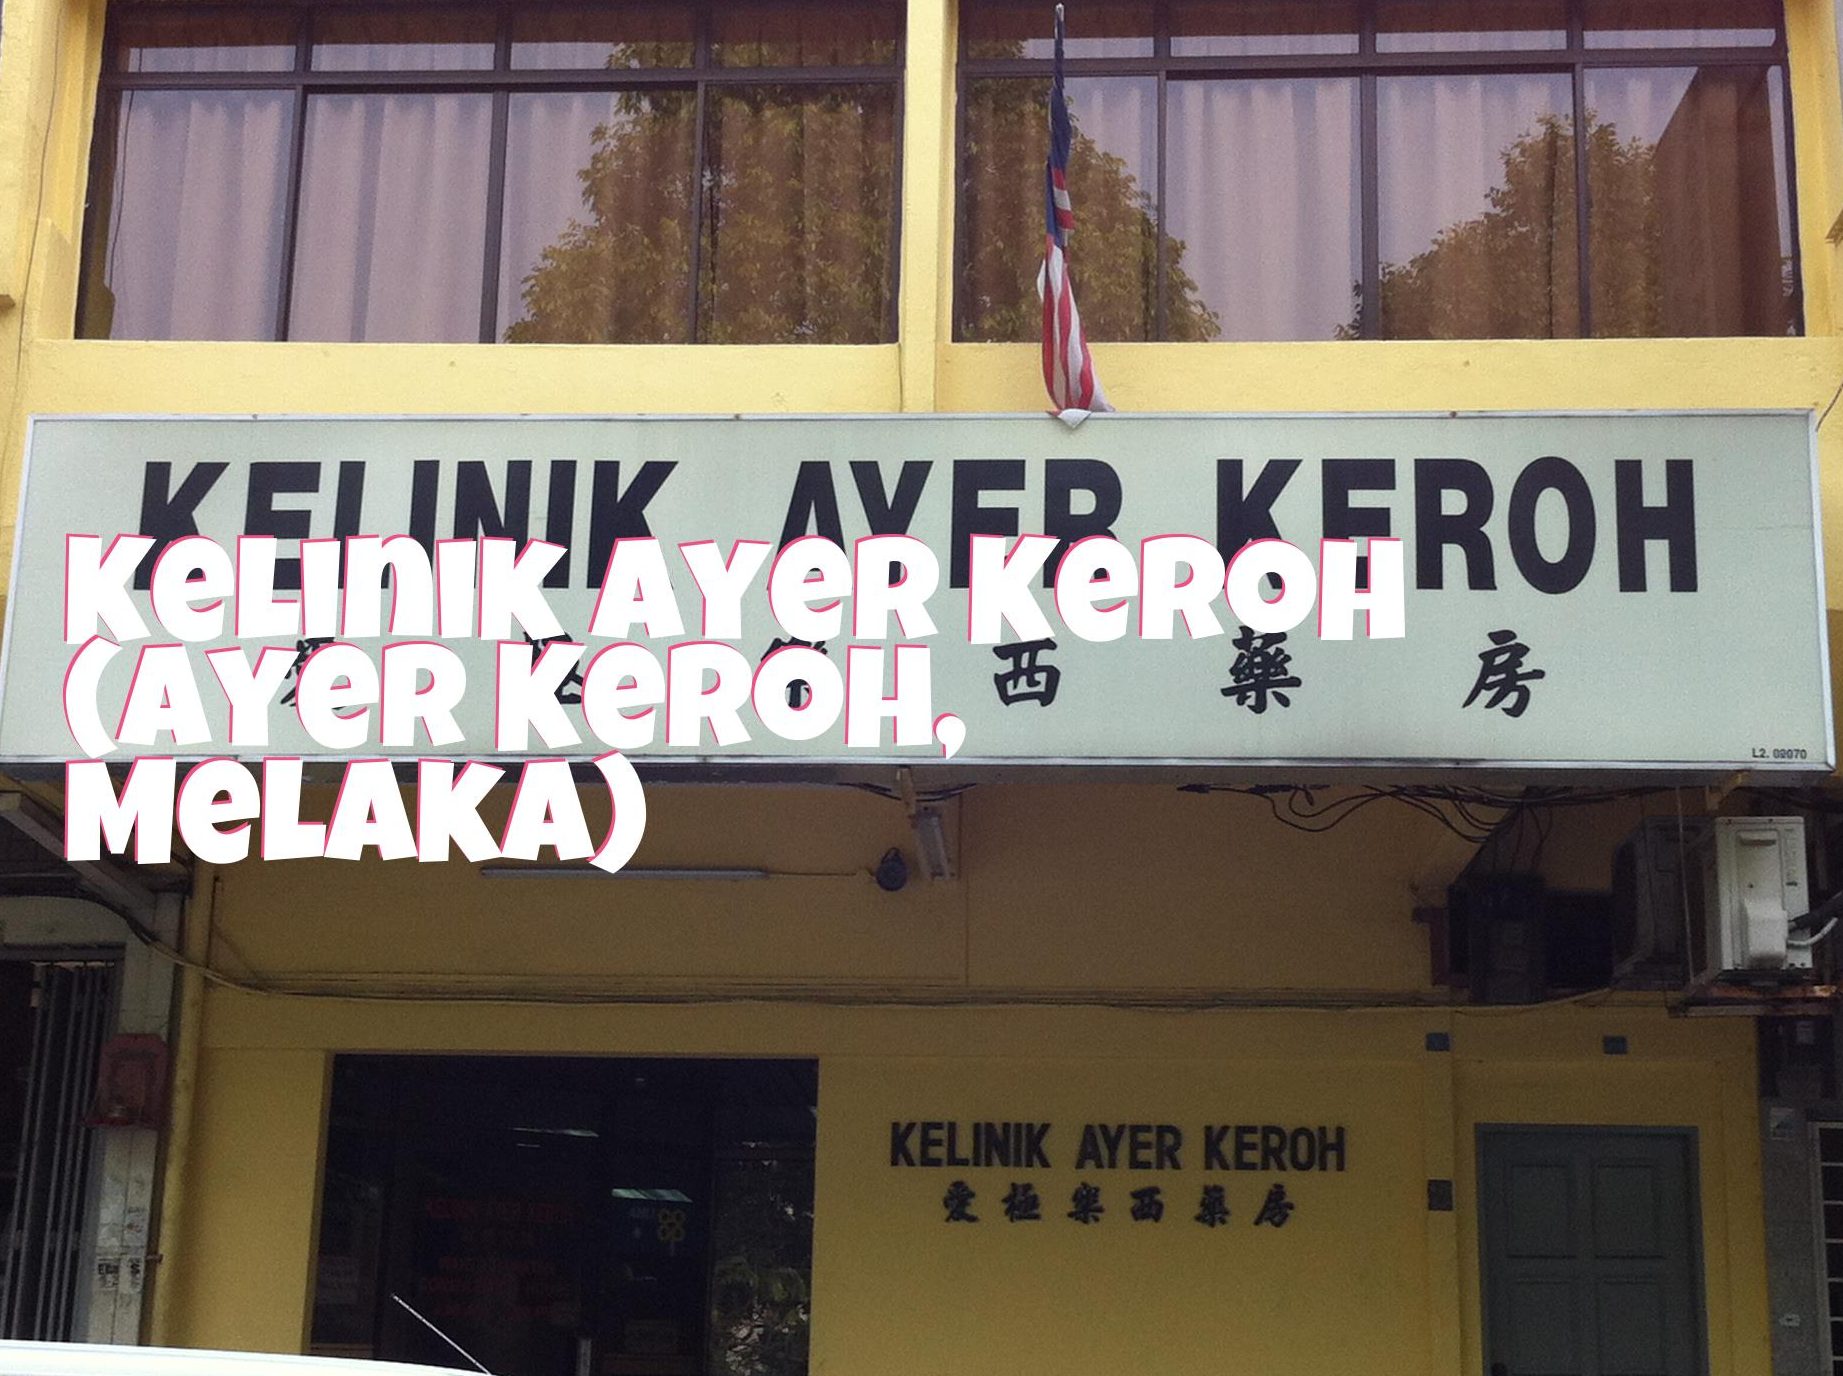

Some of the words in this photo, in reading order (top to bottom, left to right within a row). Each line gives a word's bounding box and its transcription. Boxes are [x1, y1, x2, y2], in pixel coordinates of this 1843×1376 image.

[1216, 456, 1699, 595] KEROH
[890, 1121, 1052, 1168] KELINIK
[1074, 1123, 1183, 1171] AYER
[1203, 1124, 1347, 1172] KEROH
